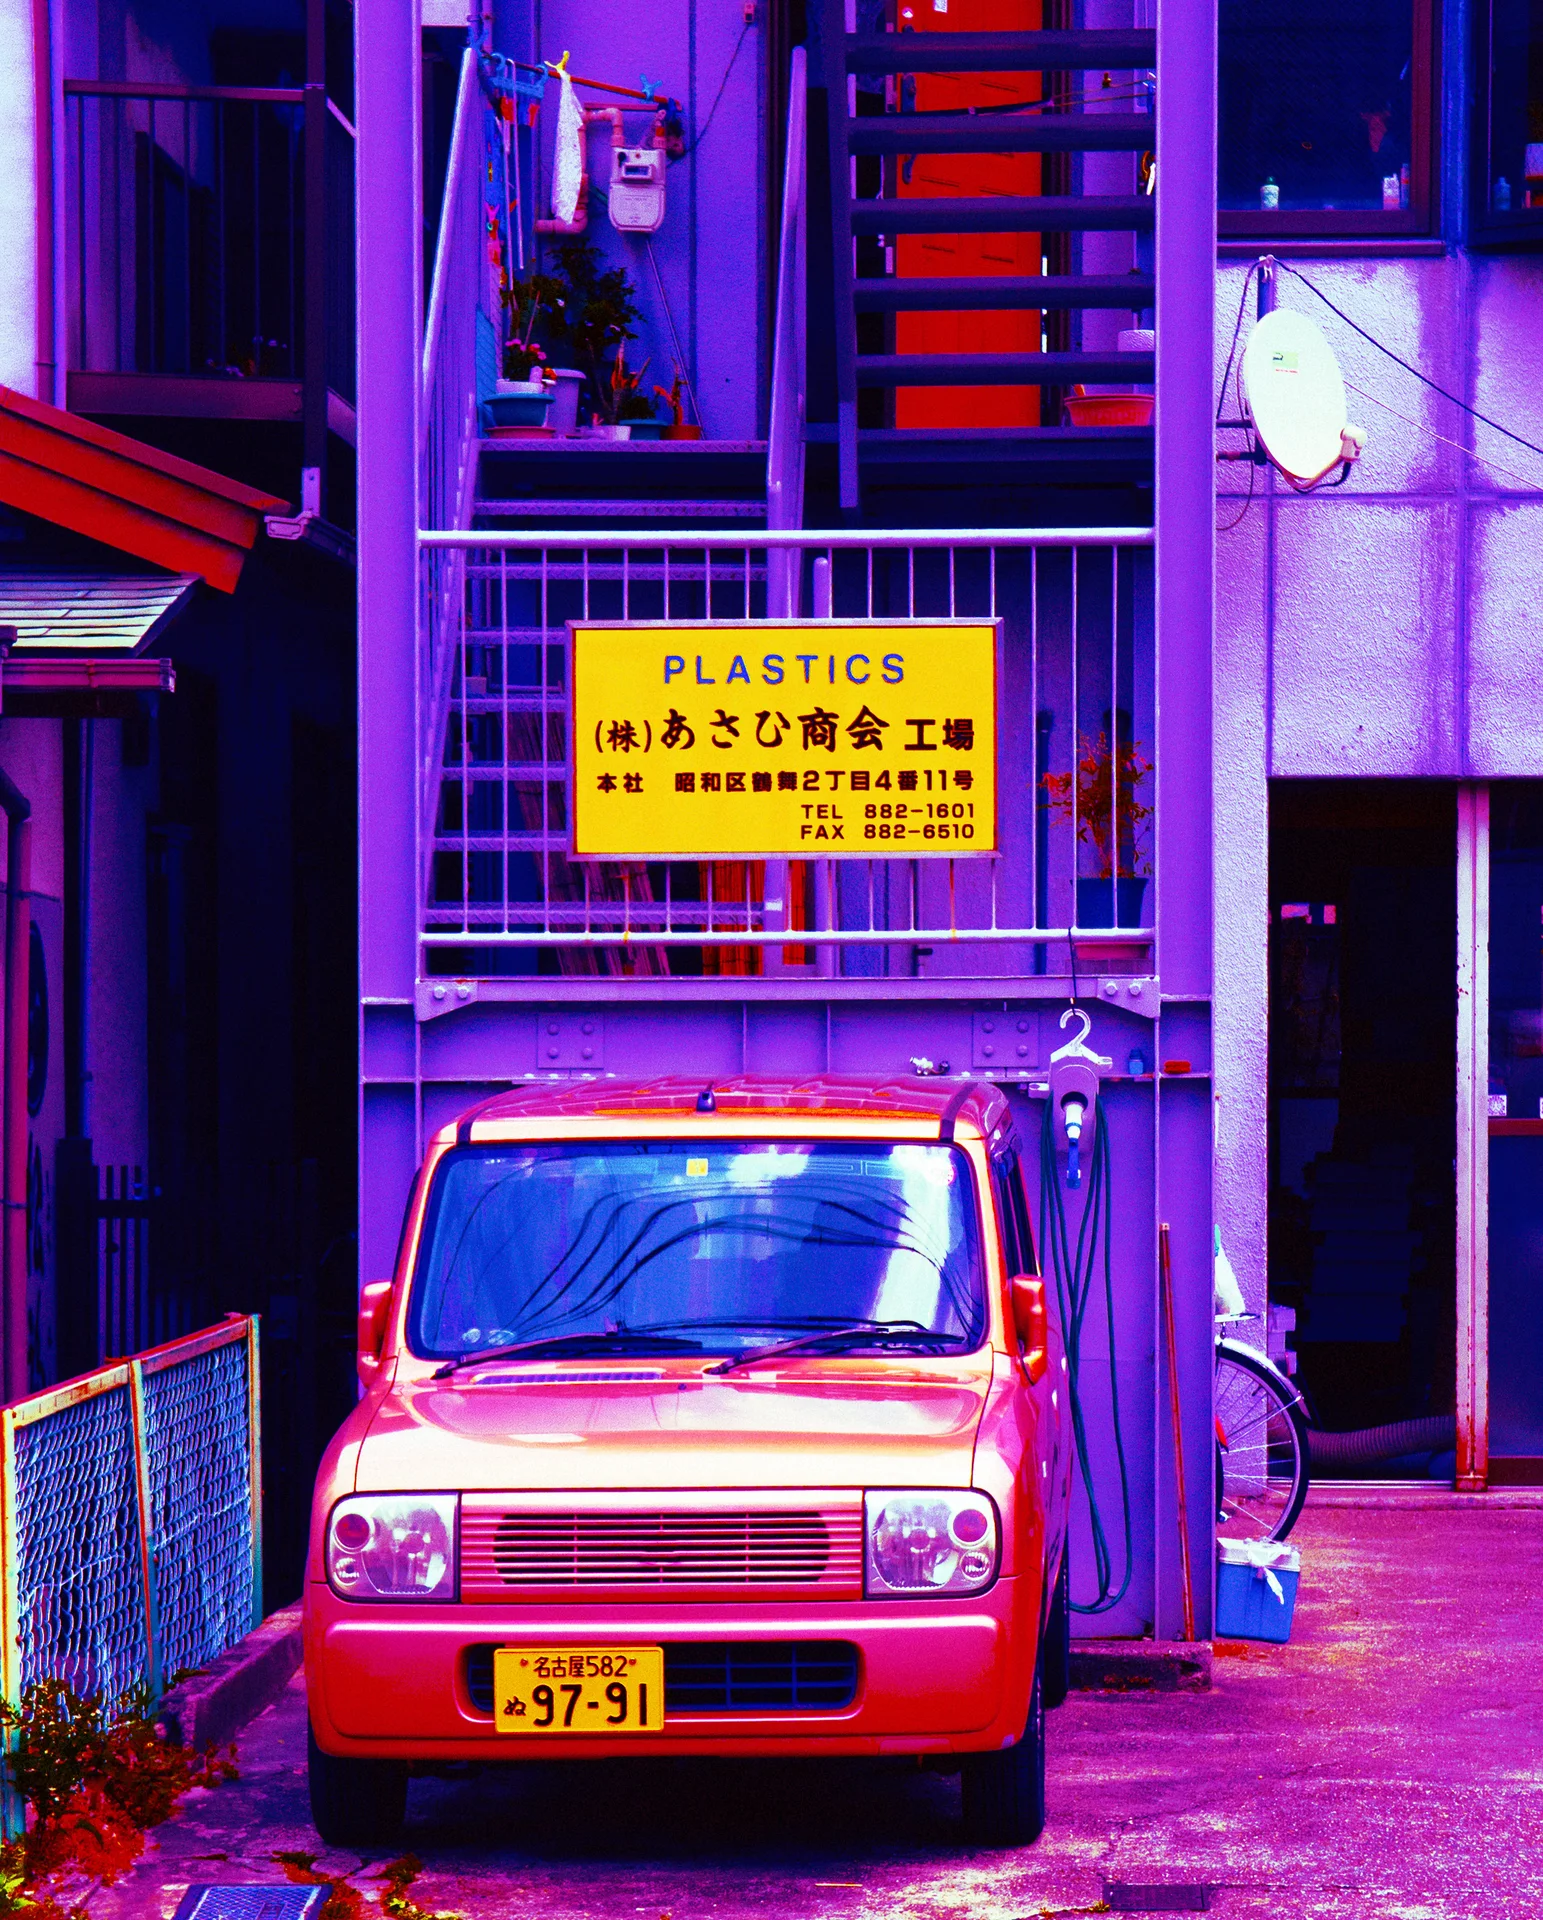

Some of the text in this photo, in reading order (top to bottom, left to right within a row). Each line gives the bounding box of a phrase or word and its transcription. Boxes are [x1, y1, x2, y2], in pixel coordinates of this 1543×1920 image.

[663, 654, 905, 685] PLASTICS
[904, 717, 975, 752] 工場
[596, 769, 975, 794] 本社 昭和区鶴舞2丁目4番11号
[801, 802, 975, 820] TEL 882-1601
[800, 823, 975, 840] FAX 882-6510
[532, 1654, 628, 1679] 名古屋582
[503, 1681, 648, 1728] ぬ 97-91
